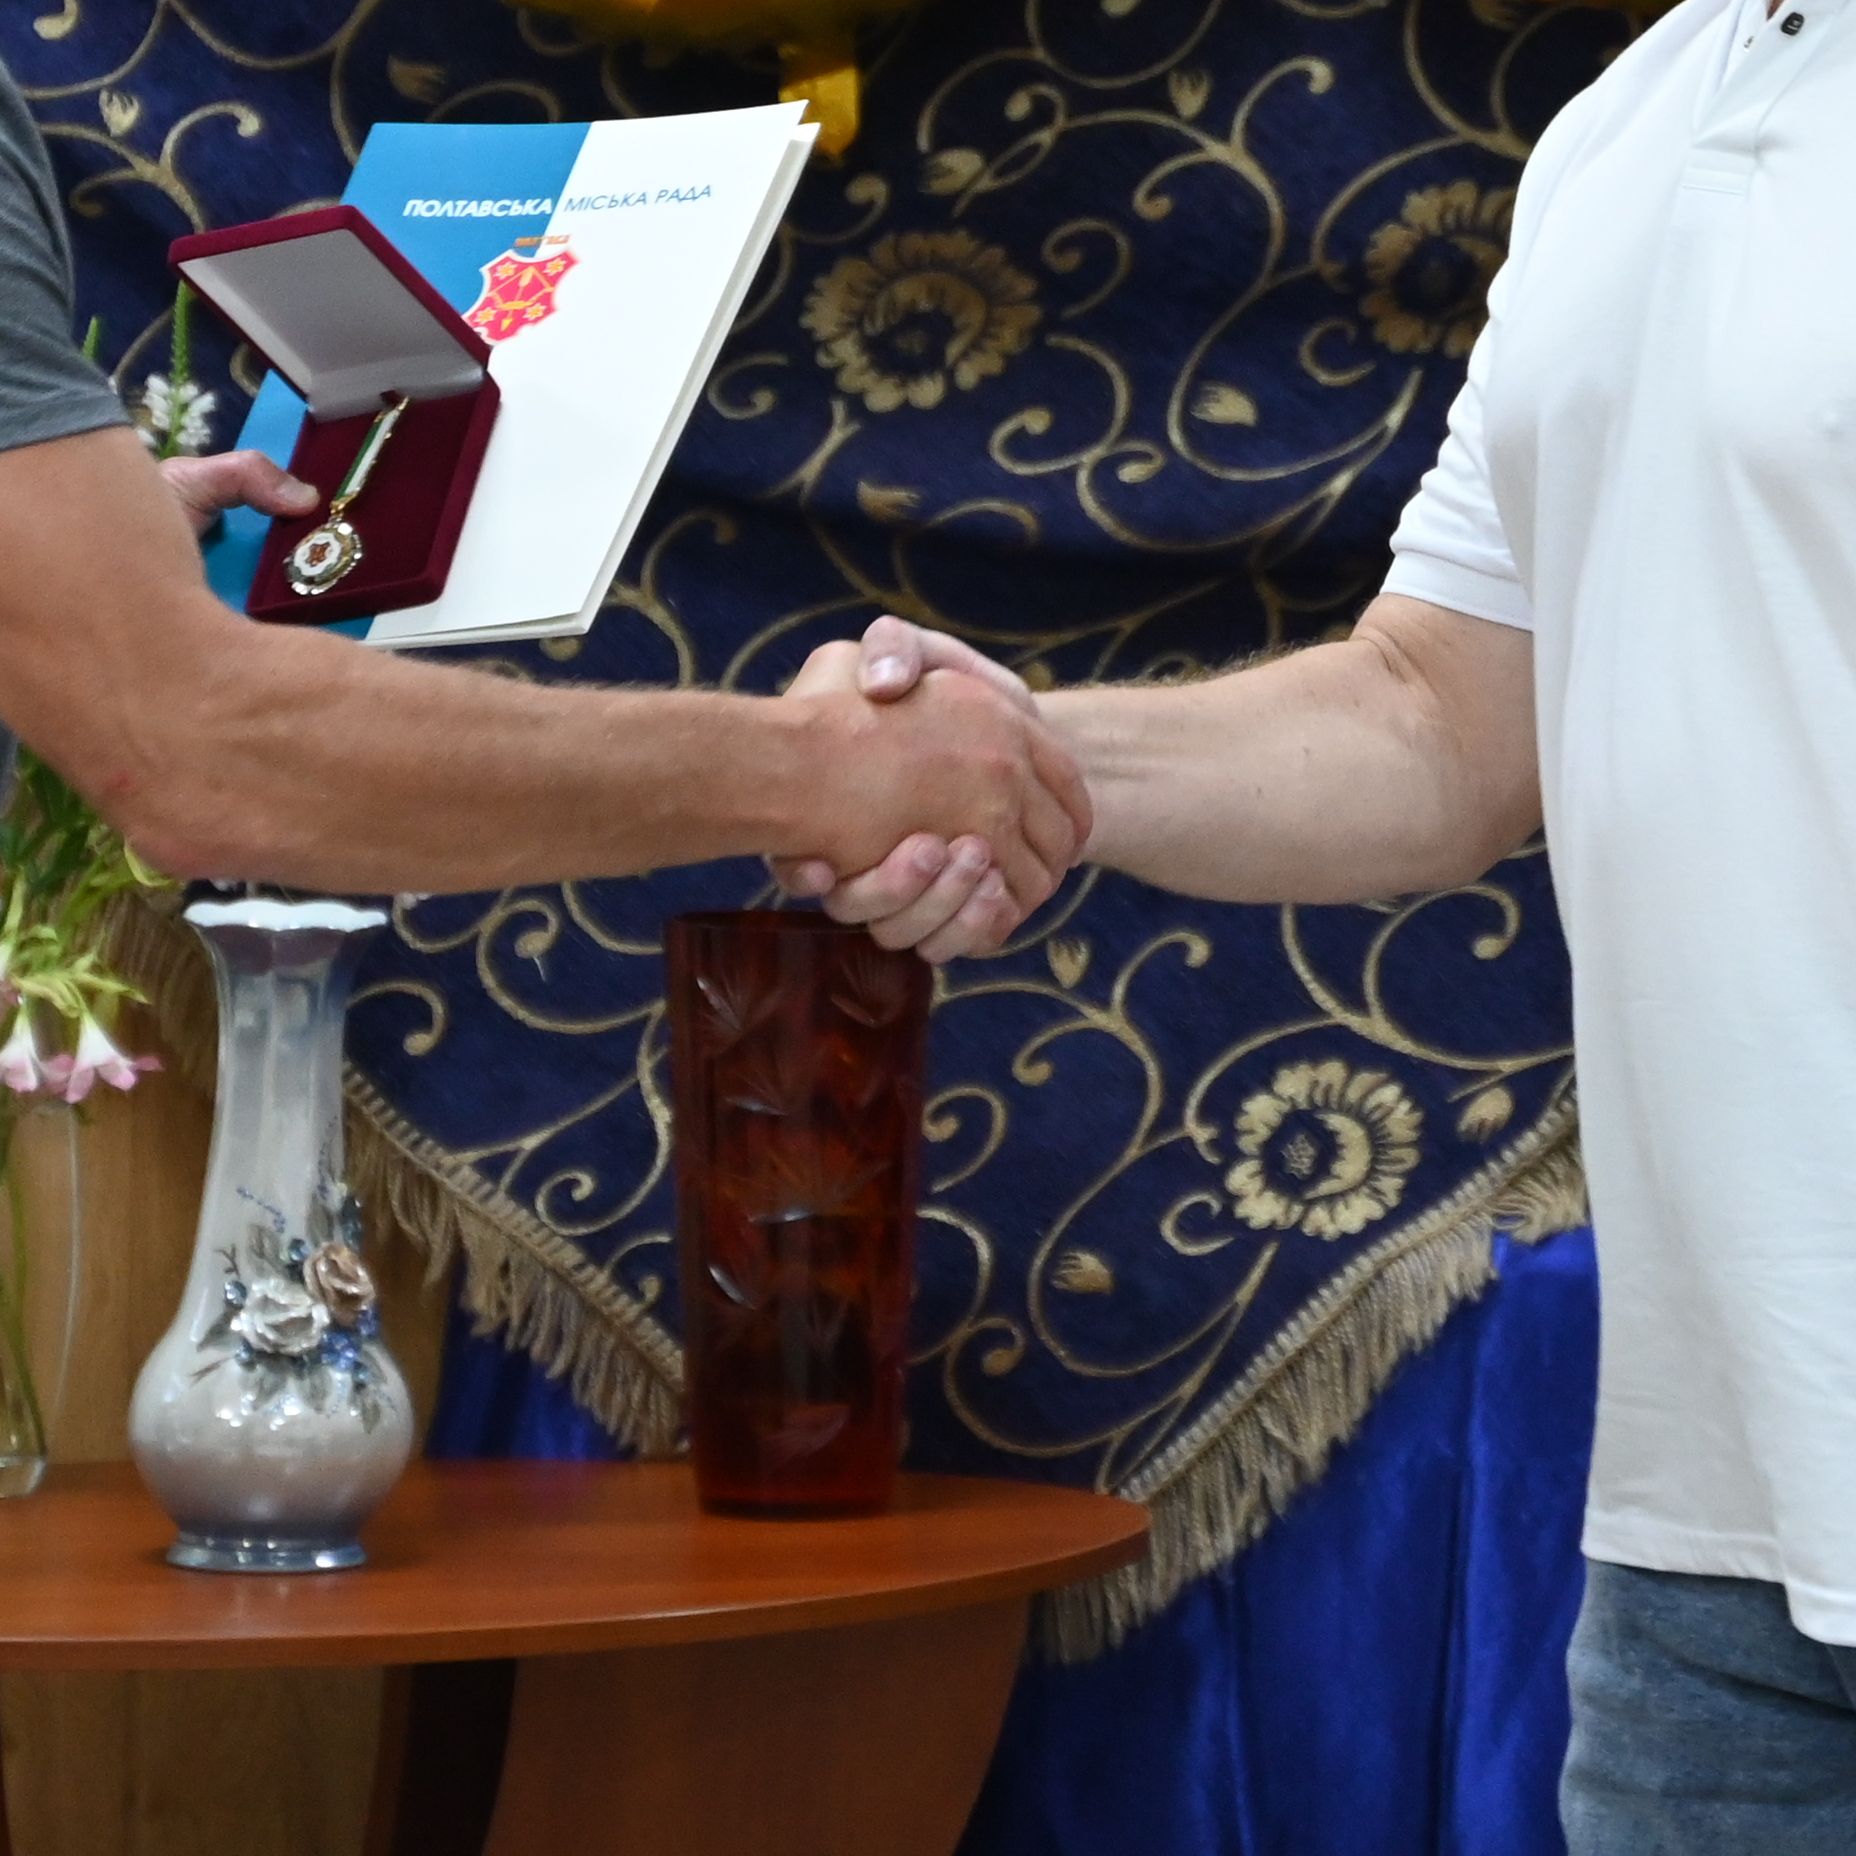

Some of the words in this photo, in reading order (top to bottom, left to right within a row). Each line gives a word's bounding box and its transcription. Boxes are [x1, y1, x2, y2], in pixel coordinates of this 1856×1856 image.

[402, 198, 553, 217] ПОЛТАВСЬКА
[563, 192, 648, 213] МІСЬКА
[654, 184, 712, 204] РАДА
